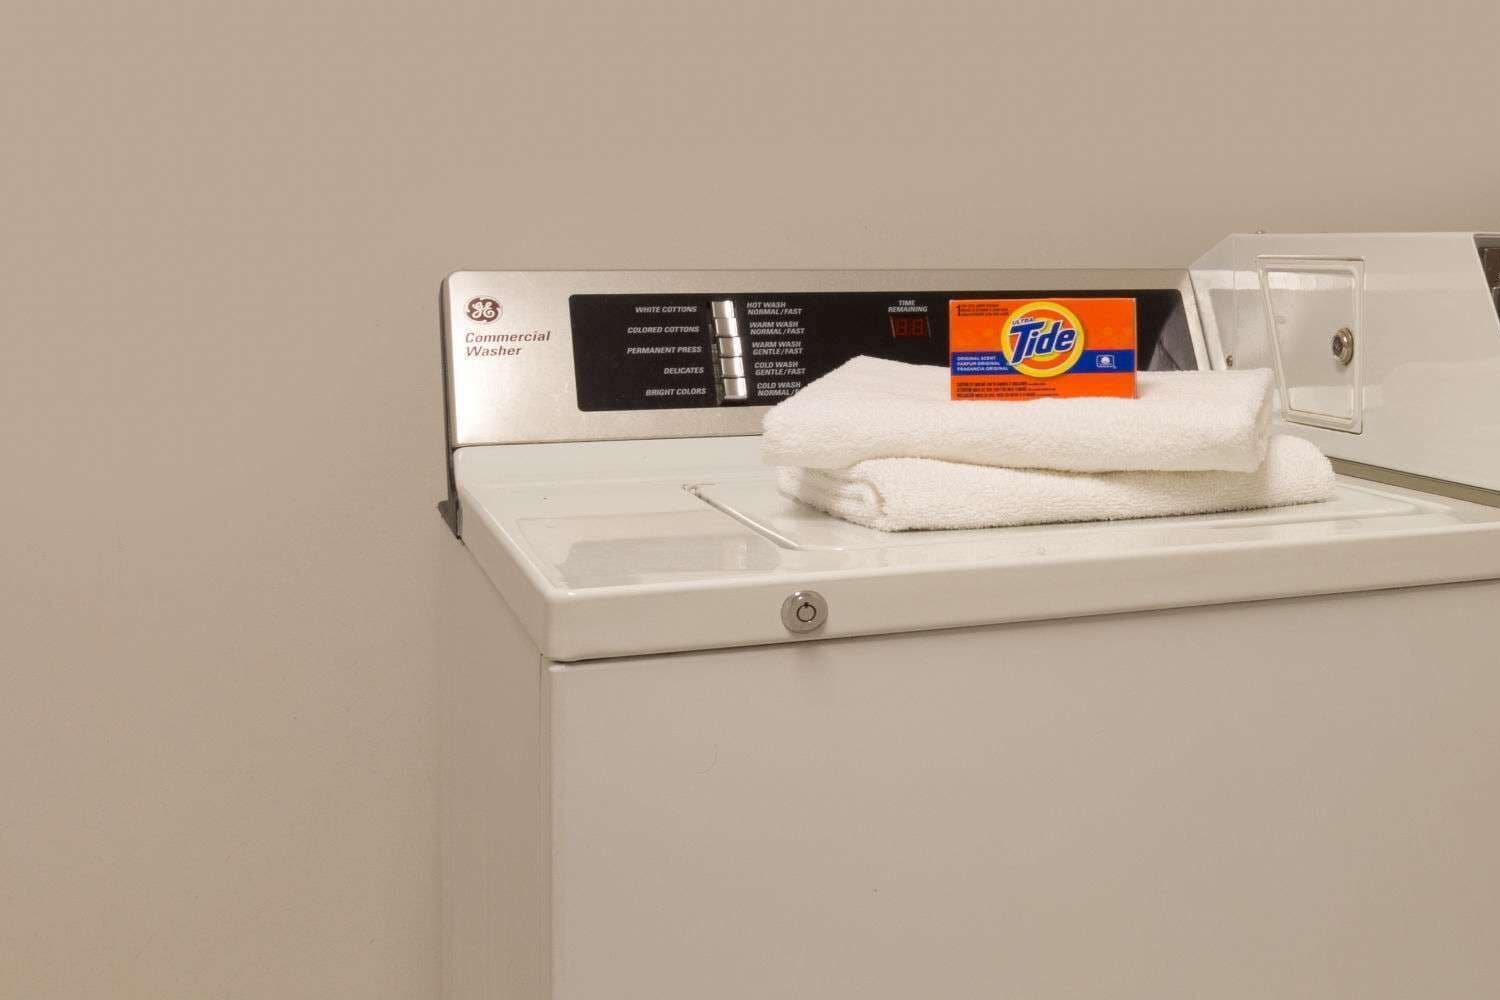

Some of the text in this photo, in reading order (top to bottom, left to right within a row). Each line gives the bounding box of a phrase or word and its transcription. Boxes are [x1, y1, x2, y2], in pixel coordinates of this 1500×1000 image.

[661, 305, 698, 313] COTTONS
[775, 320, 799, 328] WASH
[1011, 316, 1034, 326] ULTRA
[627, 326, 663, 334] COLORED
[465, 330, 551, 343] Commercial
[1008, 320, 1077, 366] Tide
[466, 345, 522, 357] Washer
[626, 346, 676, 355] PERMANENT
[663, 367, 705, 375] DELICATES
[777, 381, 801, 389] WASH
[645, 387, 707, 396] BRIGHT COLORS
